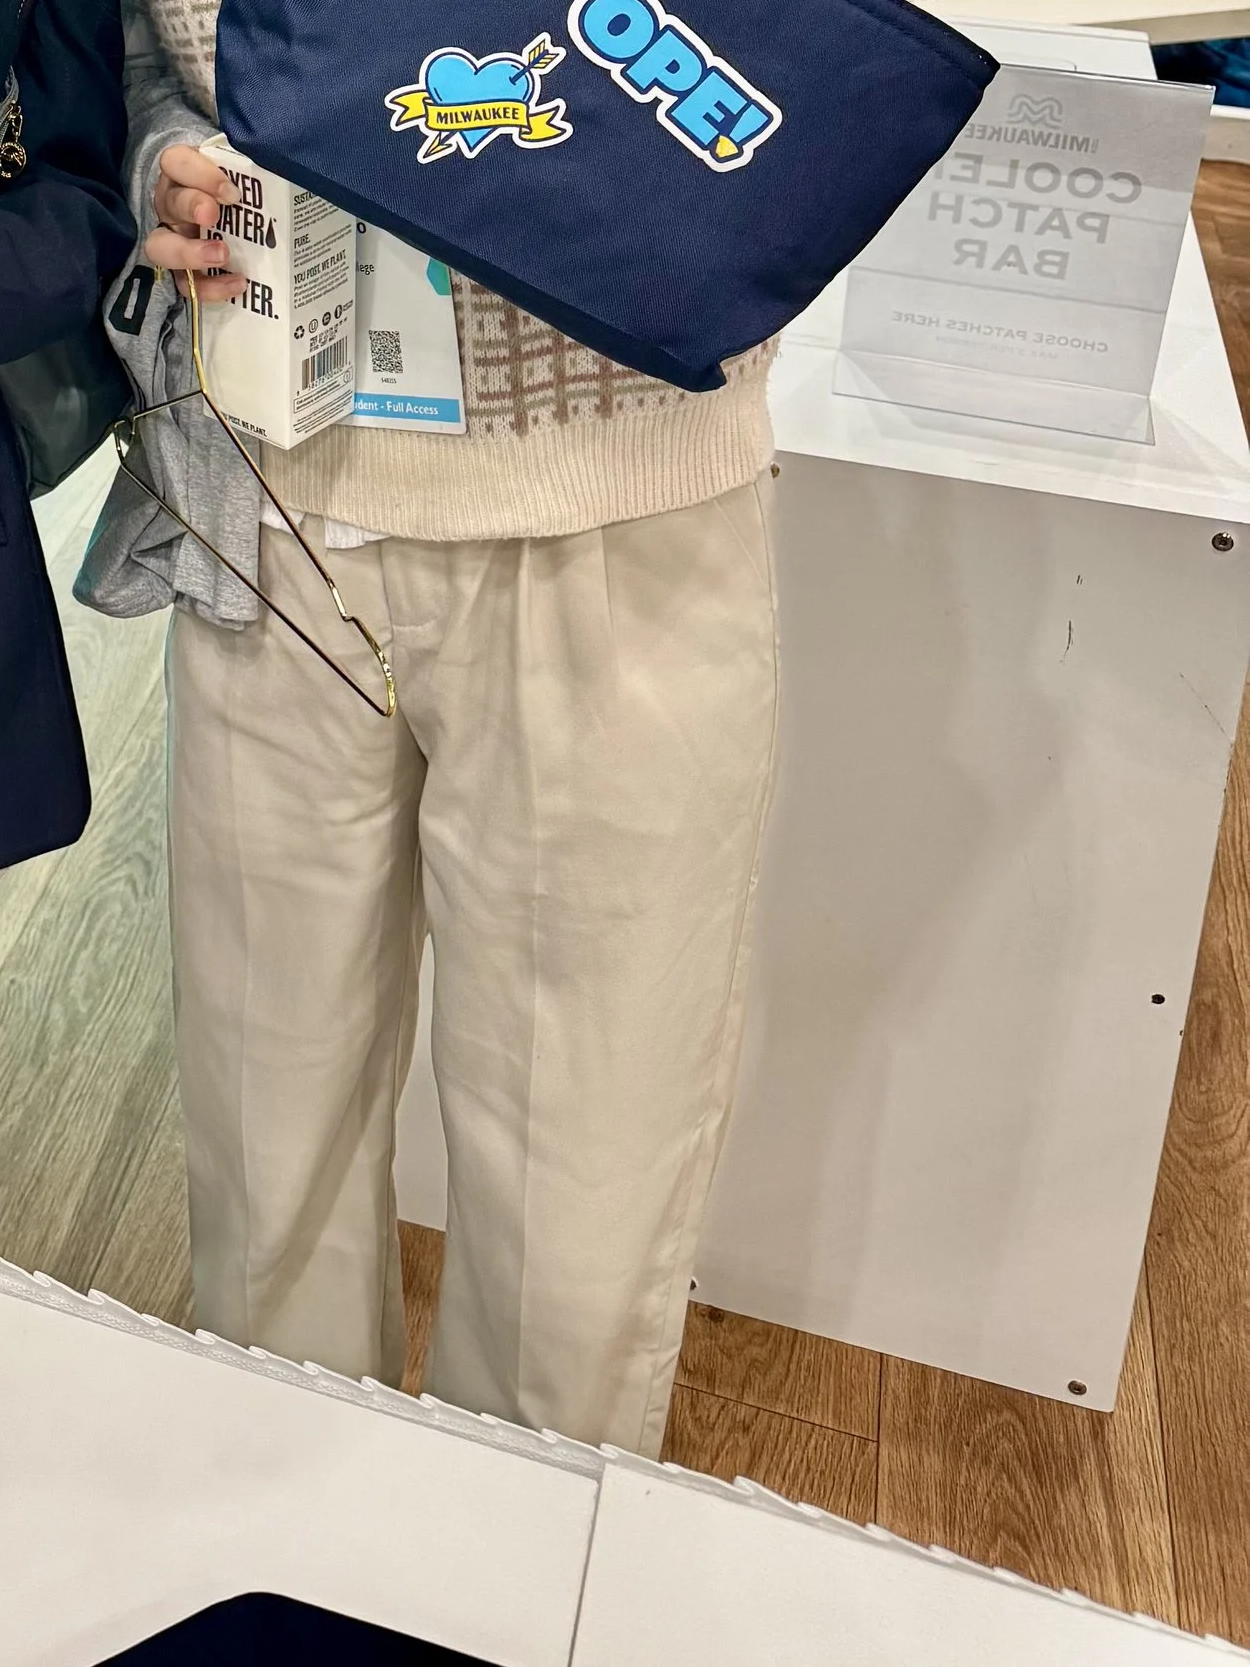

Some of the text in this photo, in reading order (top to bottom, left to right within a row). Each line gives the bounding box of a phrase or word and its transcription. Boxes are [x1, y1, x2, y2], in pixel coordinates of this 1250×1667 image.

[436, 107, 520, 125] MILWAUKEE
[218, 166, 263, 210] XED
[386, 400, 405, 414] Full
[406, 402, 440, 416] Access
